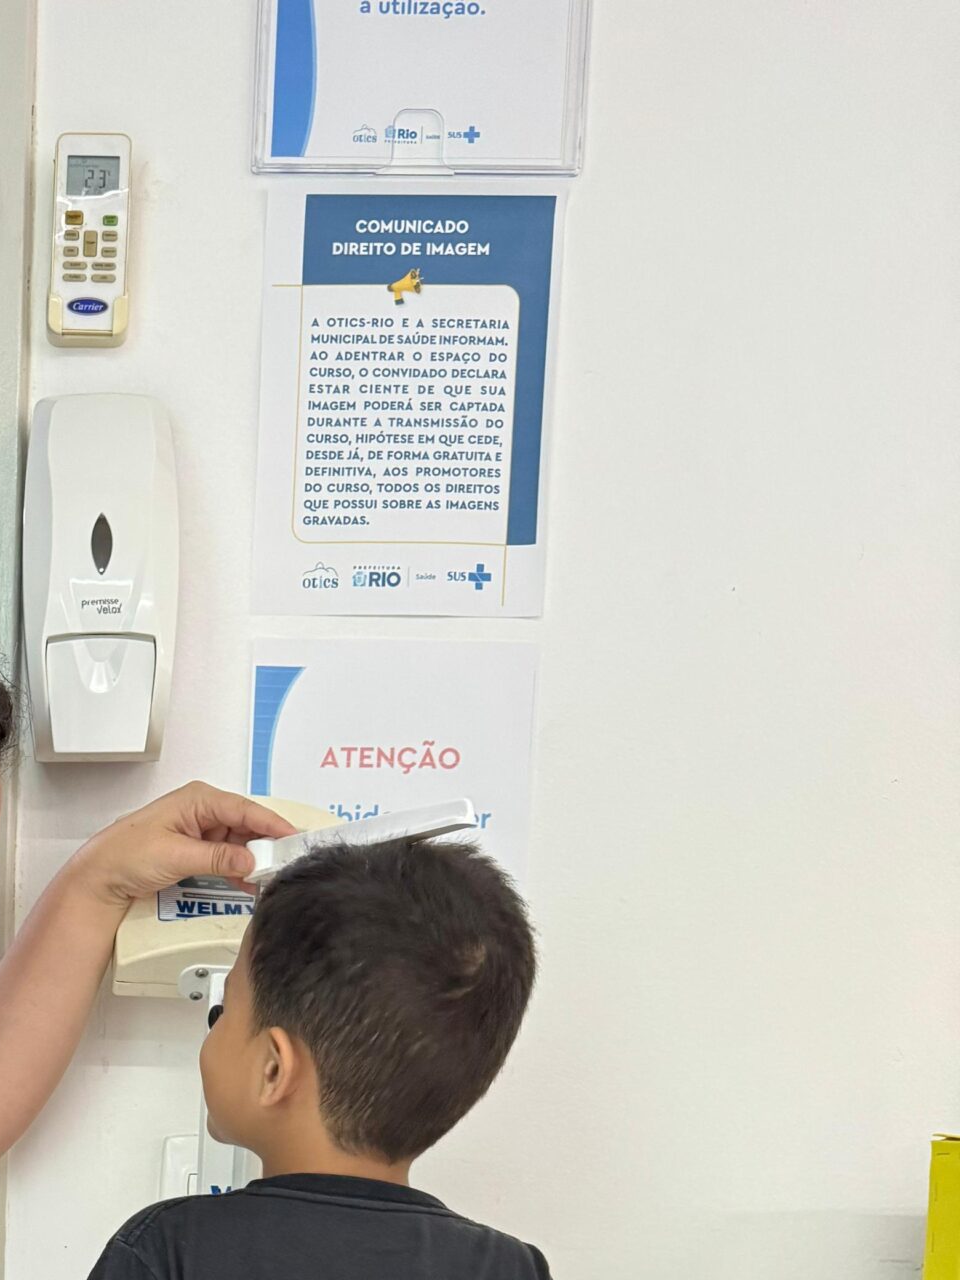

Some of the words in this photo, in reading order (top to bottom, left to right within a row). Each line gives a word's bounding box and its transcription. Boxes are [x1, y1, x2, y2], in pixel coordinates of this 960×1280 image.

[397, 128, 417, 139] Rio
[356, 220, 468, 233] COMUNICADO
[333, 243, 396, 255] DIREITO
[401, 243, 421, 255] DE
[427, 243, 489, 255] IMAGEM
[73, 303, 103, 311] Carrier
[312, 318, 319, 326] A
[327, 318, 394, 327] OTICS-RIO
[403, 318, 408, 327] E
[416, 319, 424, 327] A
[432, 319, 509, 329] SECRETARIA
[311, 335, 377, 344] MUNICIPAL
[379, 335, 394, 344] DE
[397, 332, 436, 344] SAÚDE
[439, 336, 508, 346] INFORMAM.
[311, 351, 328, 360] AO
[335, 352, 404, 360] ADENTRAR
[413, 352, 422, 361] O
[431, 352, 480, 364] ESPAÇO
[489, 353, 507, 362] DO
[310, 368, 354, 379] CURSO,
[359, 368, 368, 377] O
[373, 368, 447, 378] CONVIDADO
[452, 369, 506, 379] DECLARA
[309, 384, 349, 394] ESTAR
[359, 384, 408, 394] CIENTE
[418, 385, 434, 394] DE
[444, 385, 471, 397] QUE
[481, 386, 505, 395] SUA
[308, 401, 356, 410] IMAGEM
[364, 398, 412, 410] PODERÁ
[420, 402, 441, 411] SER
[450, 402, 505, 412] CAPTADA
[308, 417, 367, 427] DURANTE
[374, 418, 381, 426] A
[388, 416, 478, 428] TRANSMISSÃO
[486, 419, 503, 428] DO
[307, 434, 351, 445] CURSO,
[356, 431, 414, 443] HIPÓTESE
[418, 435, 434, 443] EM
[439, 435, 464, 446] QUE
[468, 435, 502, 447] CEDE,
[306, 450, 344, 460] DESDE
[347, 447, 363, 462] JÁ,
[368, 451, 383, 459] DE
[387, 451, 429, 460] FORMA
[433, 451, 491, 461] GRATUITA
[496, 452, 501, 461] E
[306, 467, 376, 478] DEFINITIVA,
[383, 467, 408, 476] AOS
[416, 467, 500, 478] PROMOTORES
[305, 483, 322, 492] DO
[327, 483, 372, 494] CURSO,
[377, 483, 419, 492] TODOS
[424, 483, 440, 492] OS
[446, 484, 500, 494] DIREITOS
[304, 500, 328, 511] QUE
[334, 500, 377, 509] POSSUI
[383, 500, 421, 509] SOBRE
[426, 500, 440, 509] AS
[446, 500, 499, 510] IMAGENS
[303, 516, 369, 525] GRAVADAS.
[303, 576, 339, 589] otics
[369, 572, 401, 587] RIO
[447, 572, 467, 581] SUS
[321, 741, 460, 774] ATENÇÃO
